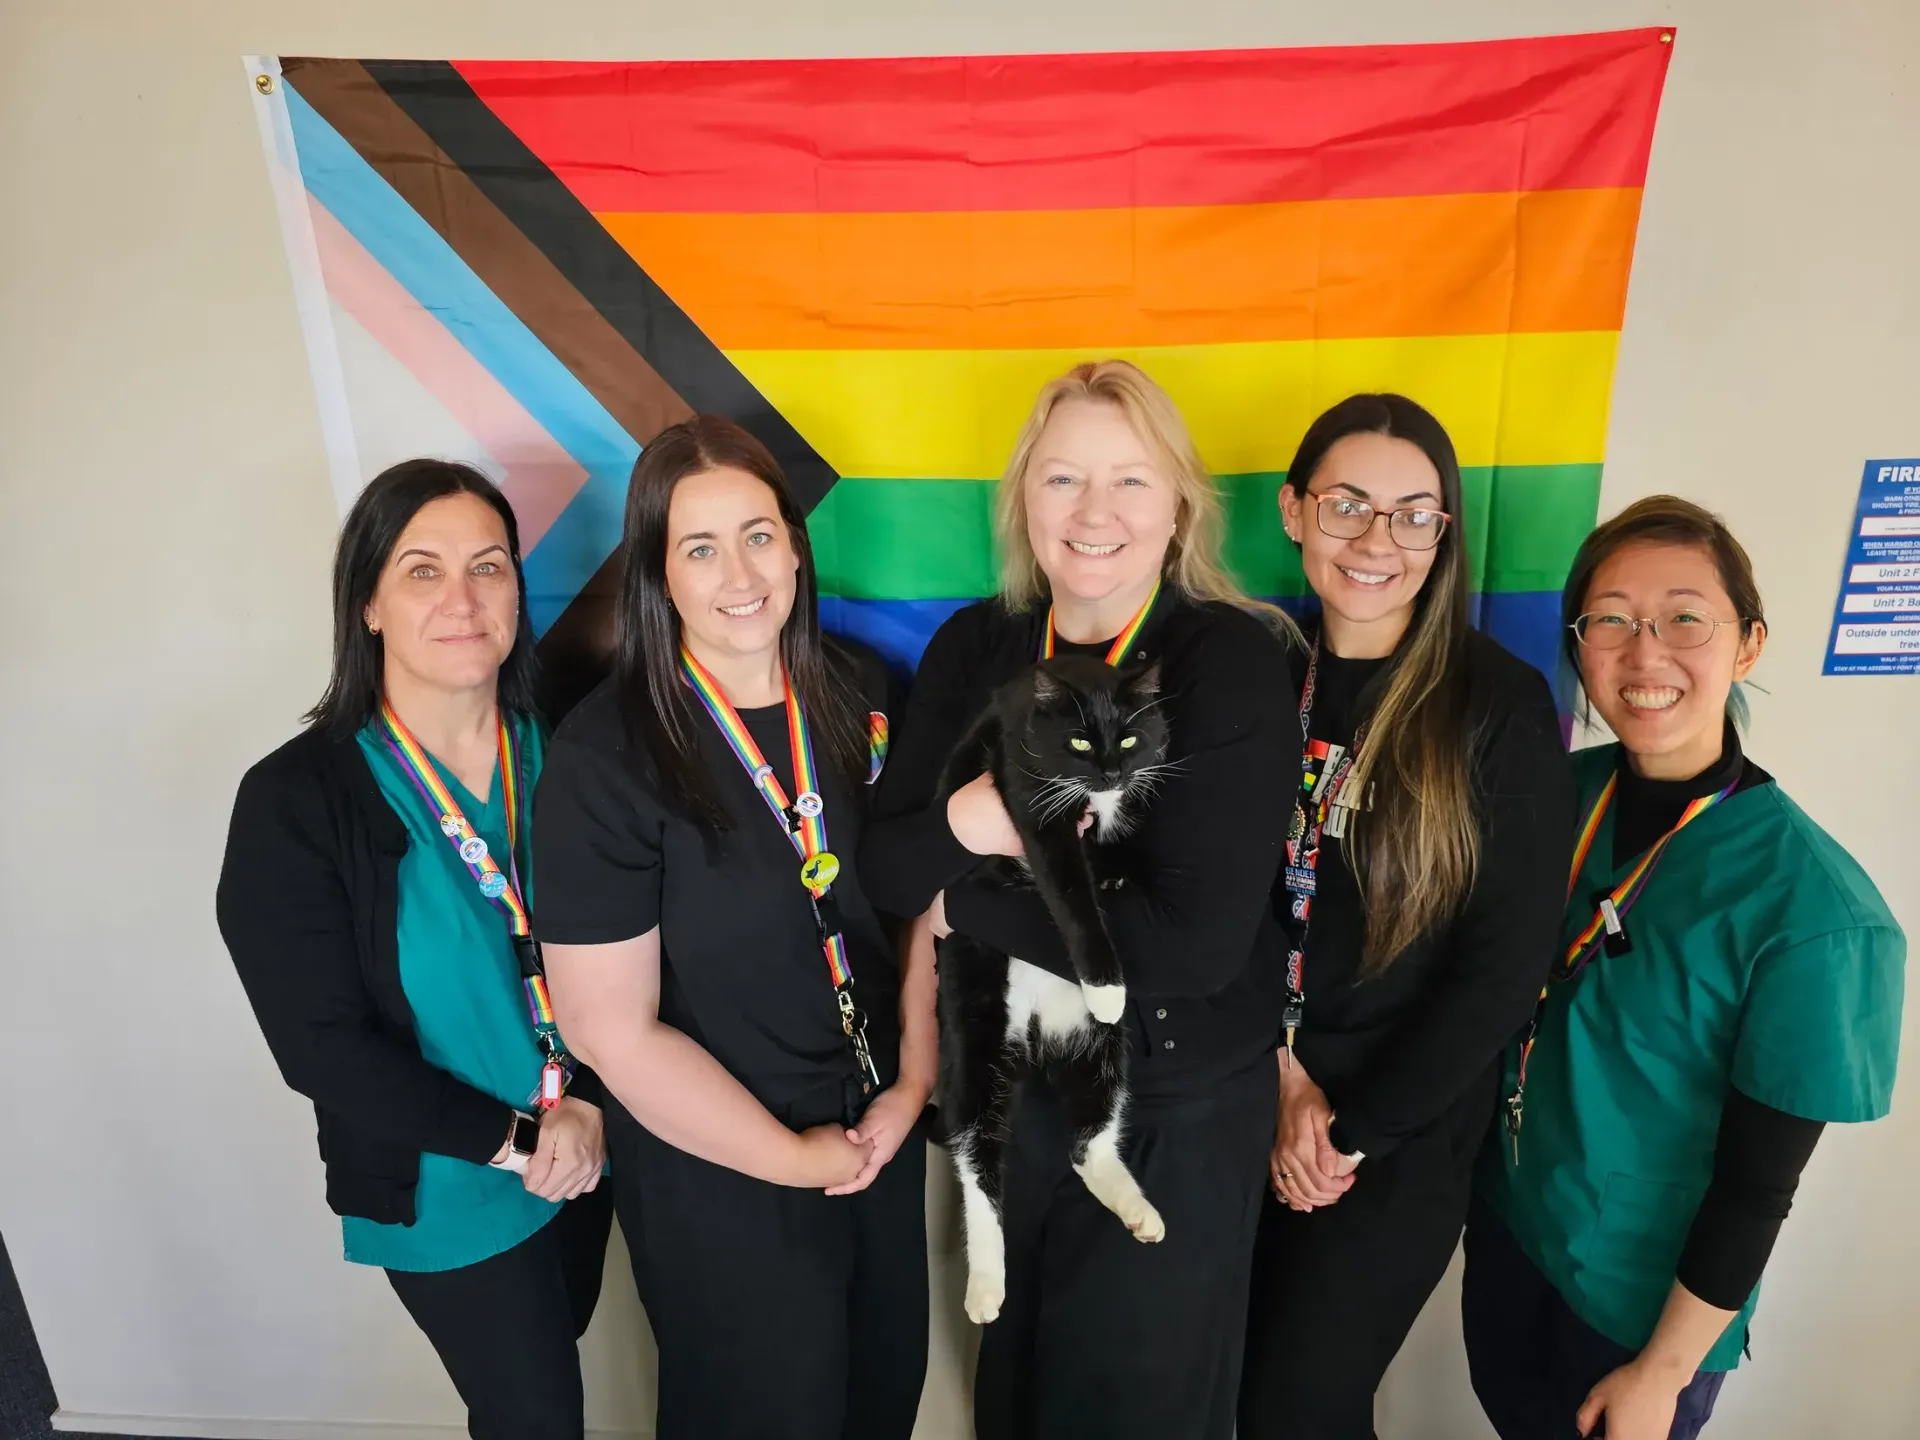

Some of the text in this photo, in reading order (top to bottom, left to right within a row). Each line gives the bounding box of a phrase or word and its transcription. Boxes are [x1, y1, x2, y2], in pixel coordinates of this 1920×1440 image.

[1877, 466, 1920, 482] FIRE
[1879, 568, 1900, 577] Unit
[1903, 568, 1910, 577] 2
[1873, 598, 1895, 607] Unit
[1898, 598, 1905, 606] 2
[1846, 628, 1920, 637] Outside under
